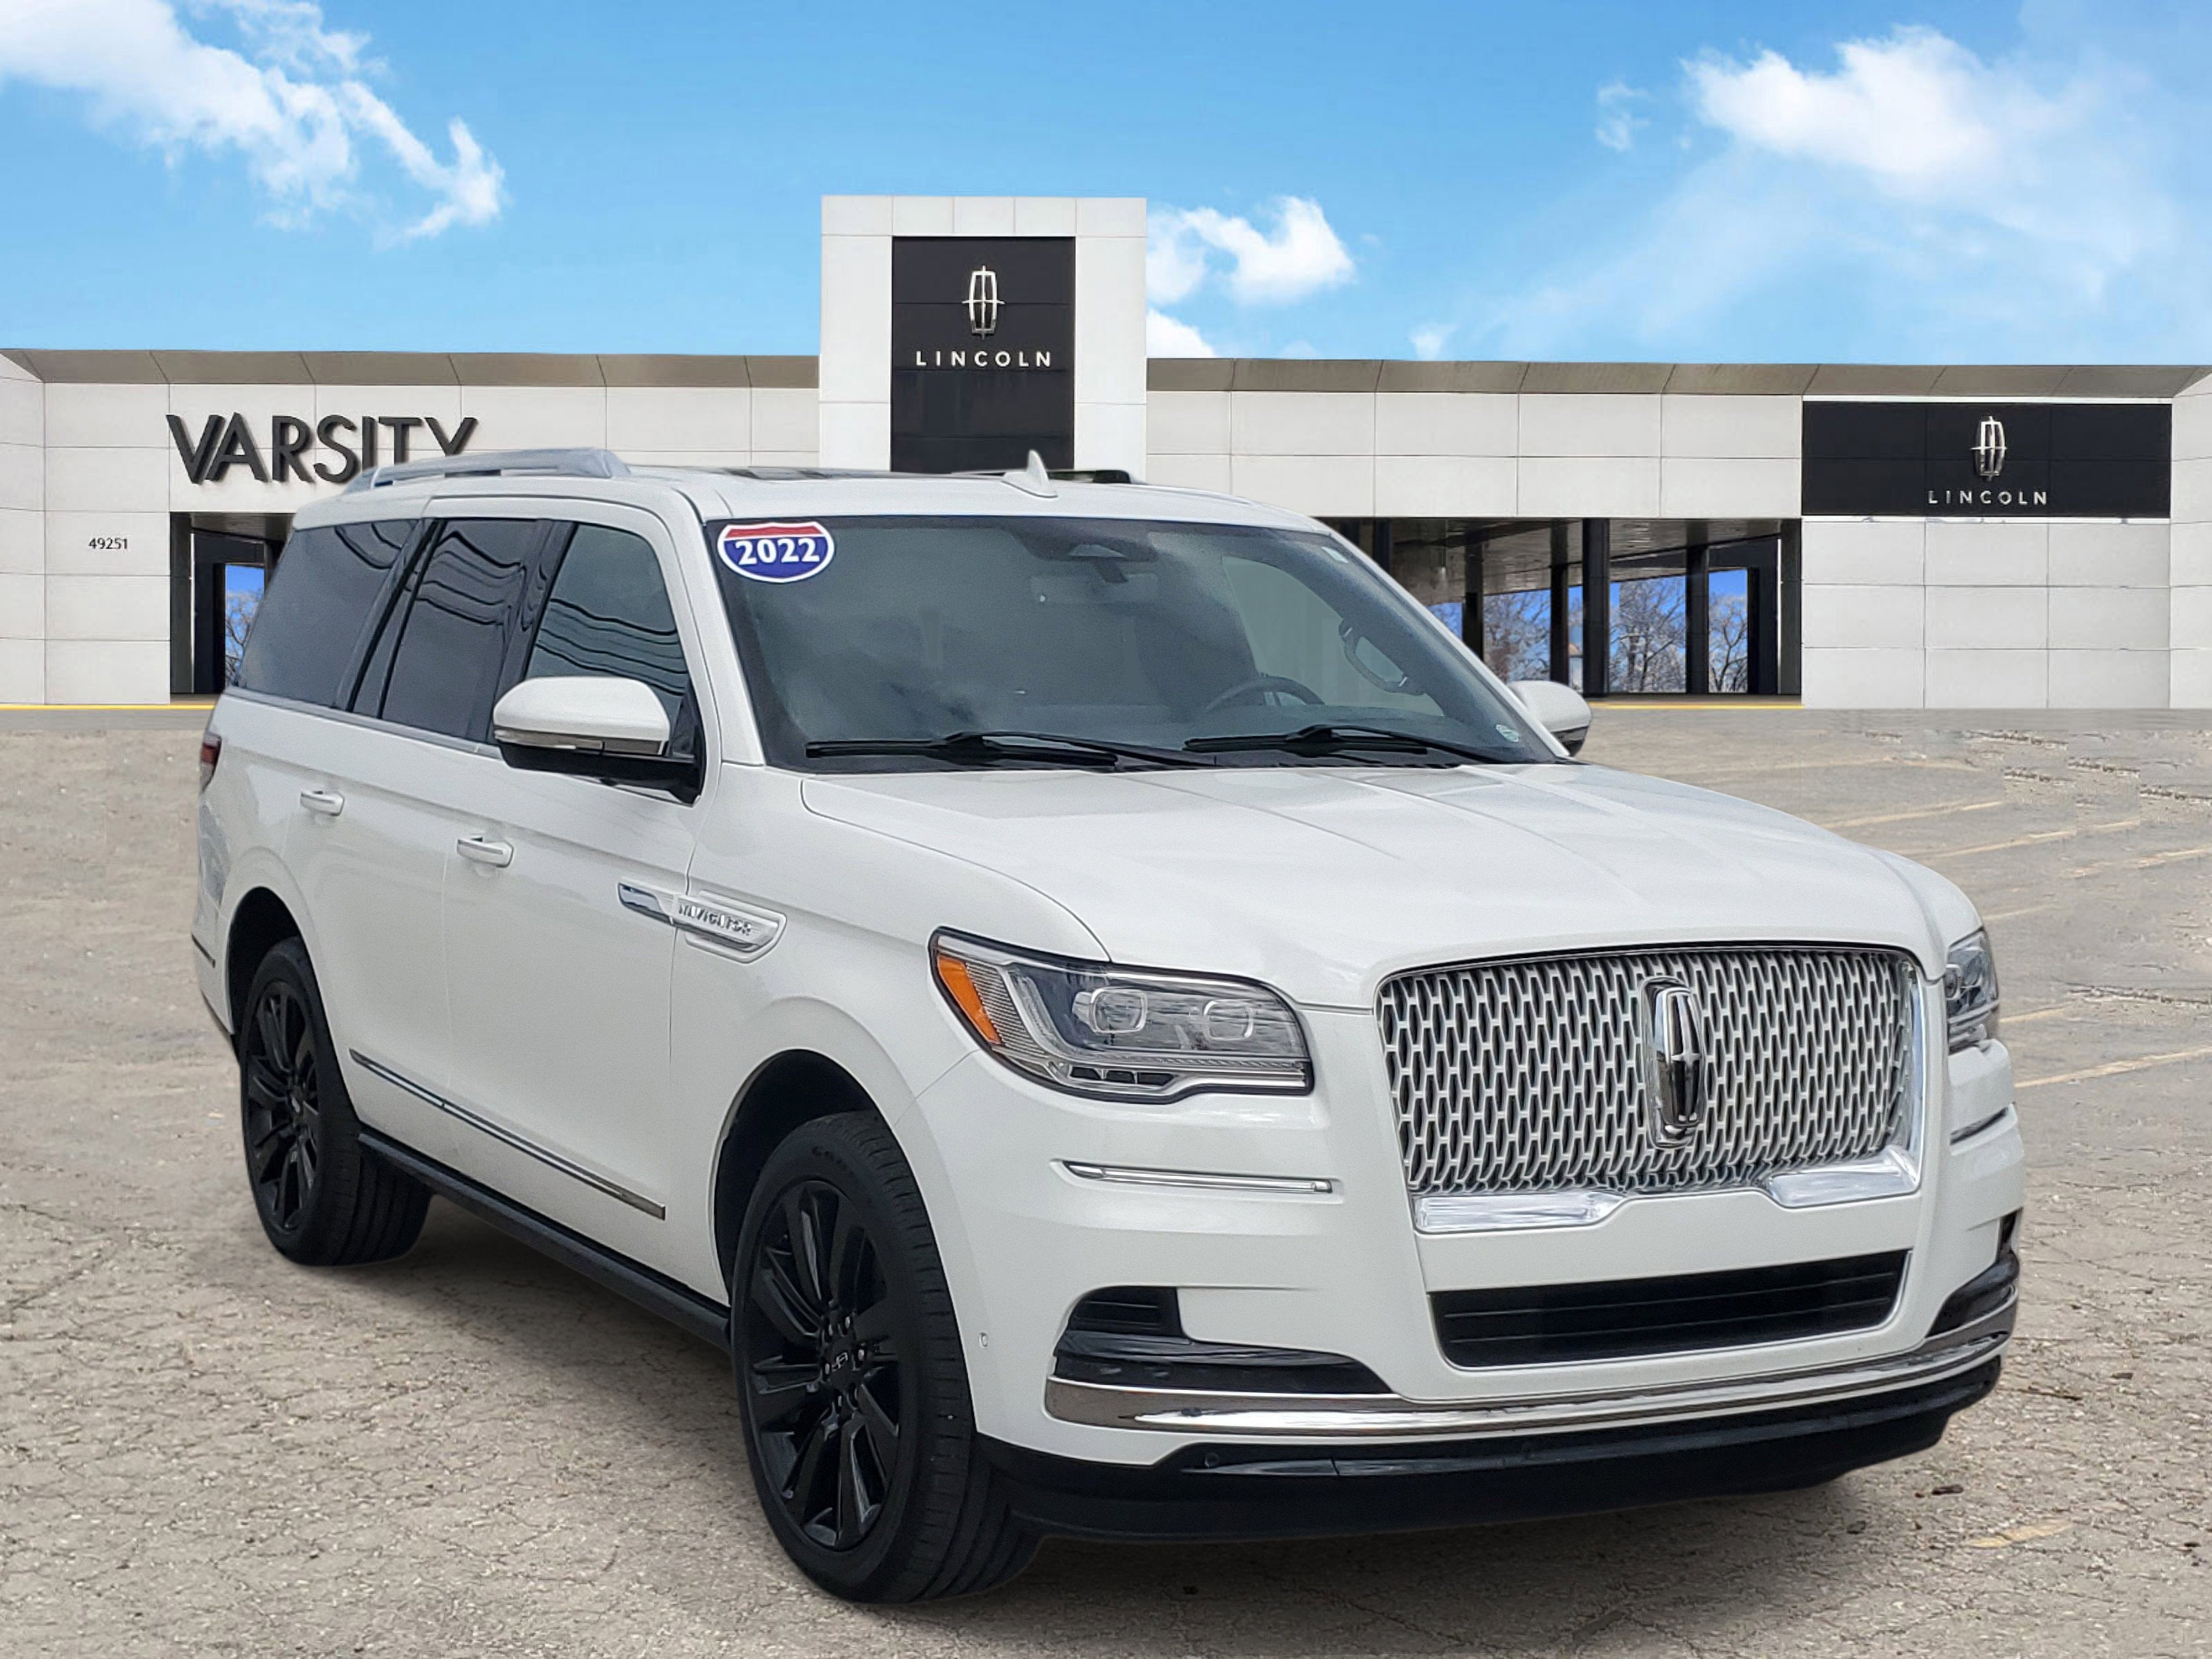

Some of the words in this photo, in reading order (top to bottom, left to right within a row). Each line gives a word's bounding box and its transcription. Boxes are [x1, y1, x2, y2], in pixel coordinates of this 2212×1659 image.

[916, 351, 1051, 367] LINCOLN
[165, 411, 478, 485] VARSITY
[1928, 491, 2047, 505] LINCOLN
[88, 537, 128, 549] 49251
[734, 538, 821, 565] 2022
